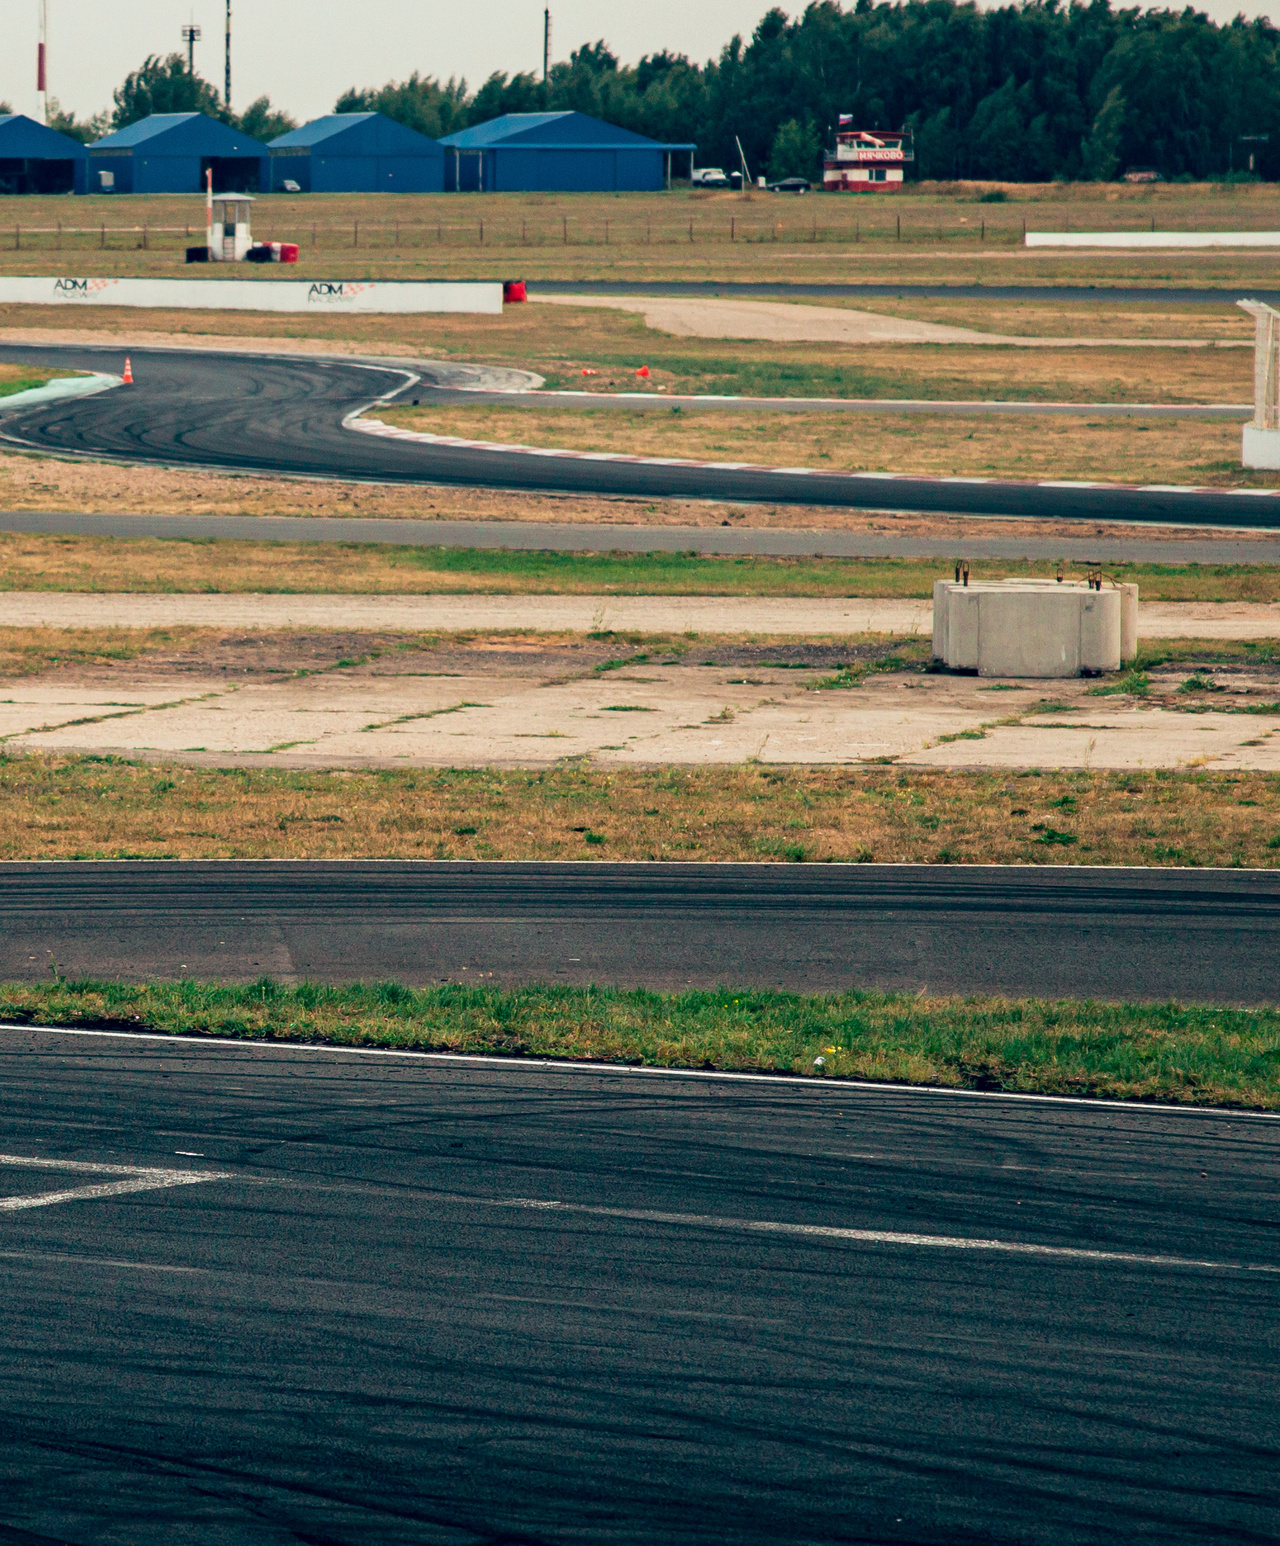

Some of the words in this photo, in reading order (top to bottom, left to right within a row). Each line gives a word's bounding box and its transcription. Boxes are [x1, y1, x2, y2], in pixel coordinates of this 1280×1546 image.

[859, 151, 903, 160] МЯЧКОВО
[54, 278, 87, 290] ADM
[308, 283, 343, 295] ADM
